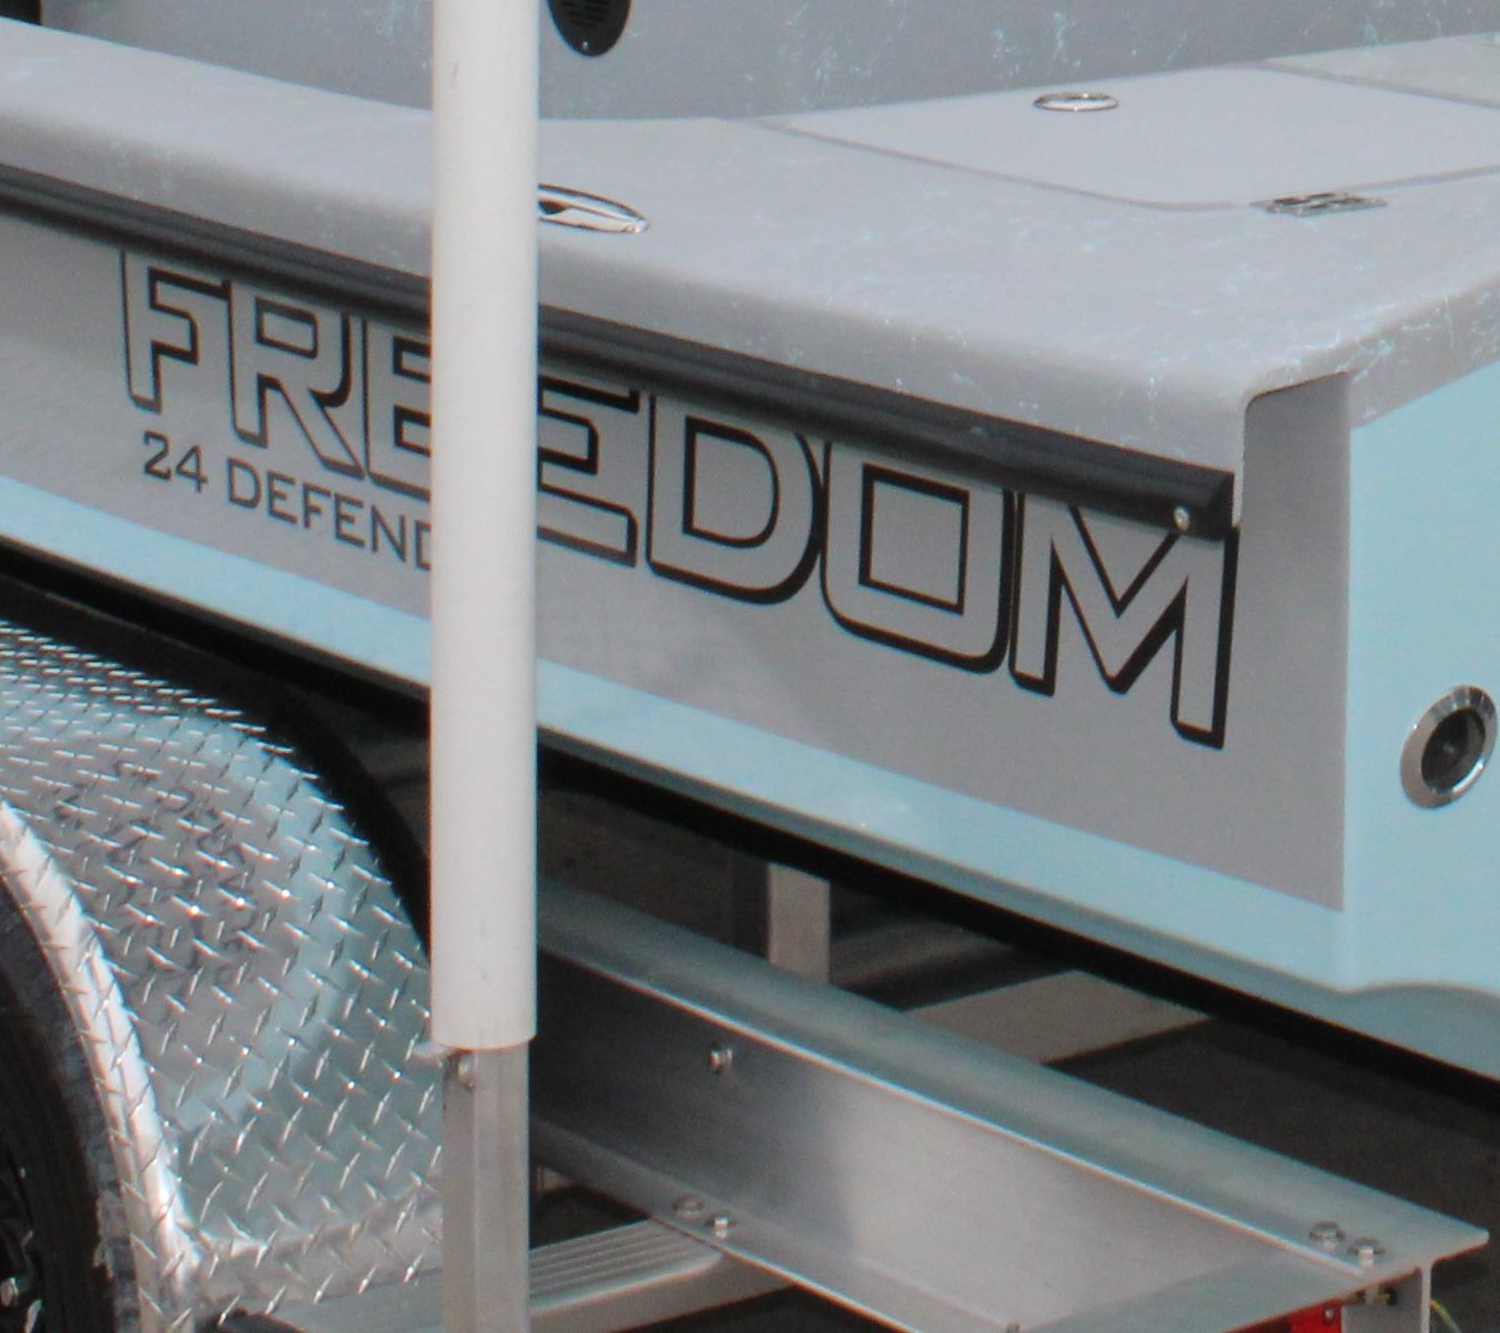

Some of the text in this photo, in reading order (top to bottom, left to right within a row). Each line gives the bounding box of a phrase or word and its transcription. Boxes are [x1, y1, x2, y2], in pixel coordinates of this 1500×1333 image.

[119, 248, 1240, 749] FREEDOM
[143, 430, 432, 573] 24 DEFEN
